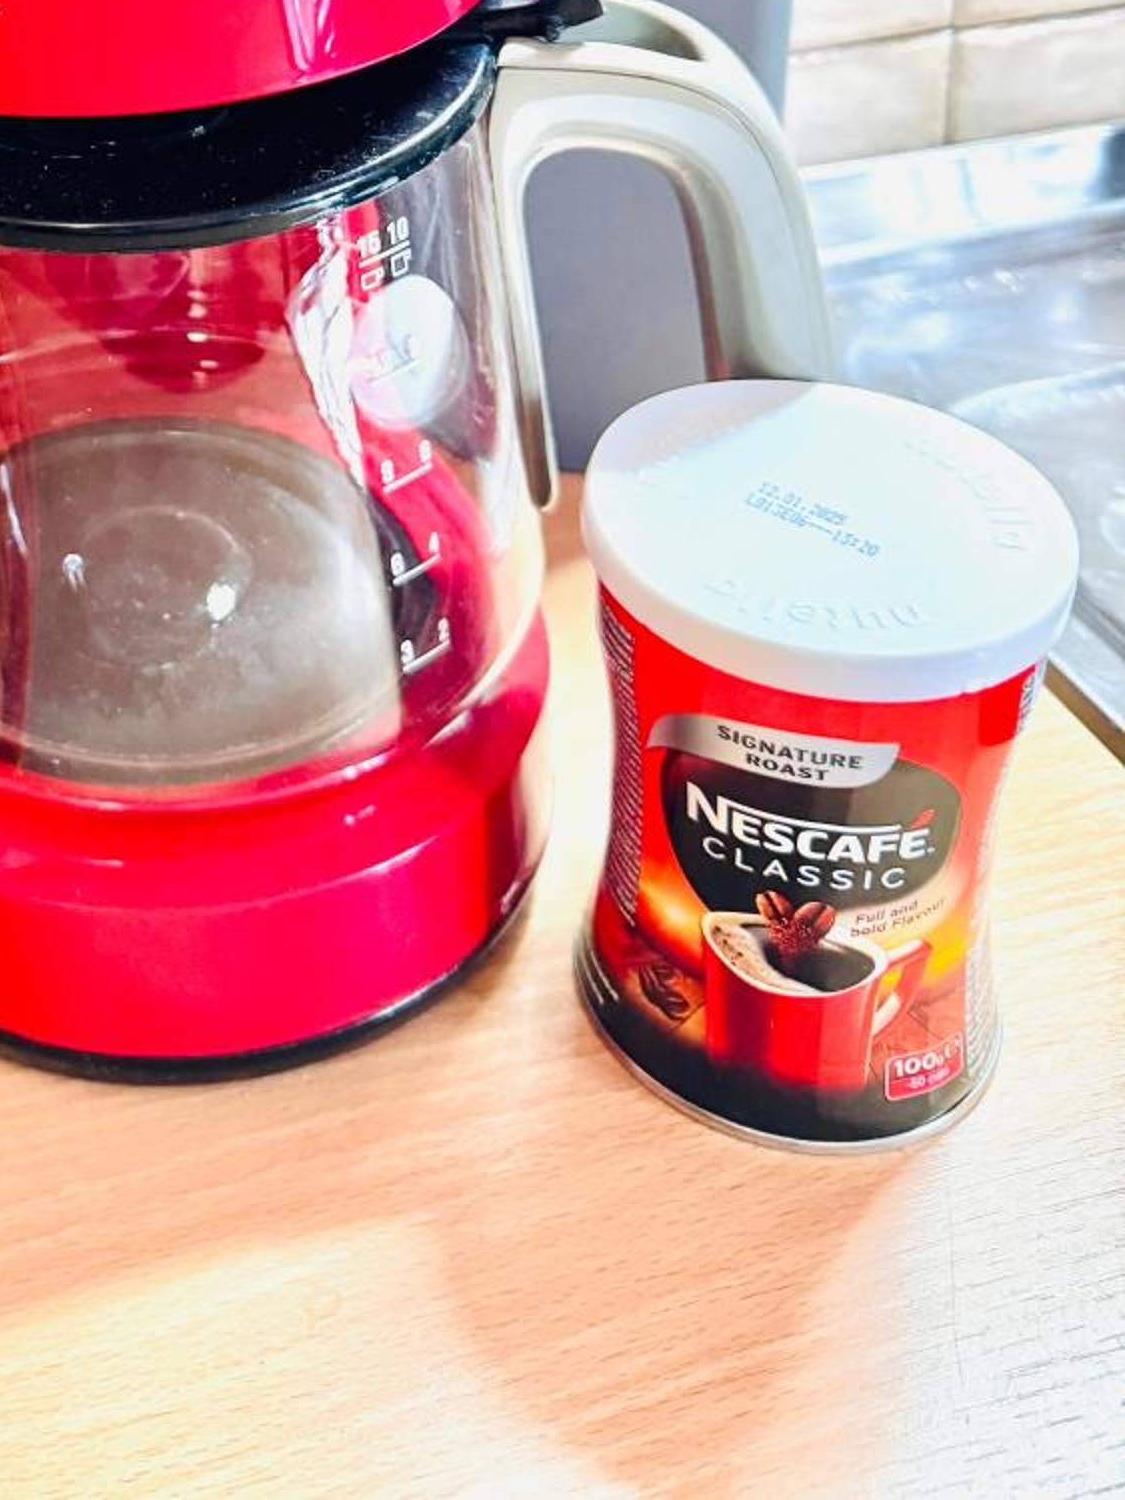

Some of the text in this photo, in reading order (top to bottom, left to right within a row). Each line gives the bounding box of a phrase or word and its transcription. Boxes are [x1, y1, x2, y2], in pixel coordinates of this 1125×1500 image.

[387, 216, 409, 245] 10
[438, 617, 450, 642] 2
[717, 724, 864, 770] SIGNATURE
[746, 753, 829, 782] ROAST
[703, 837, 907, 891] CLASSIC
[855, 907, 886, 925] Full
